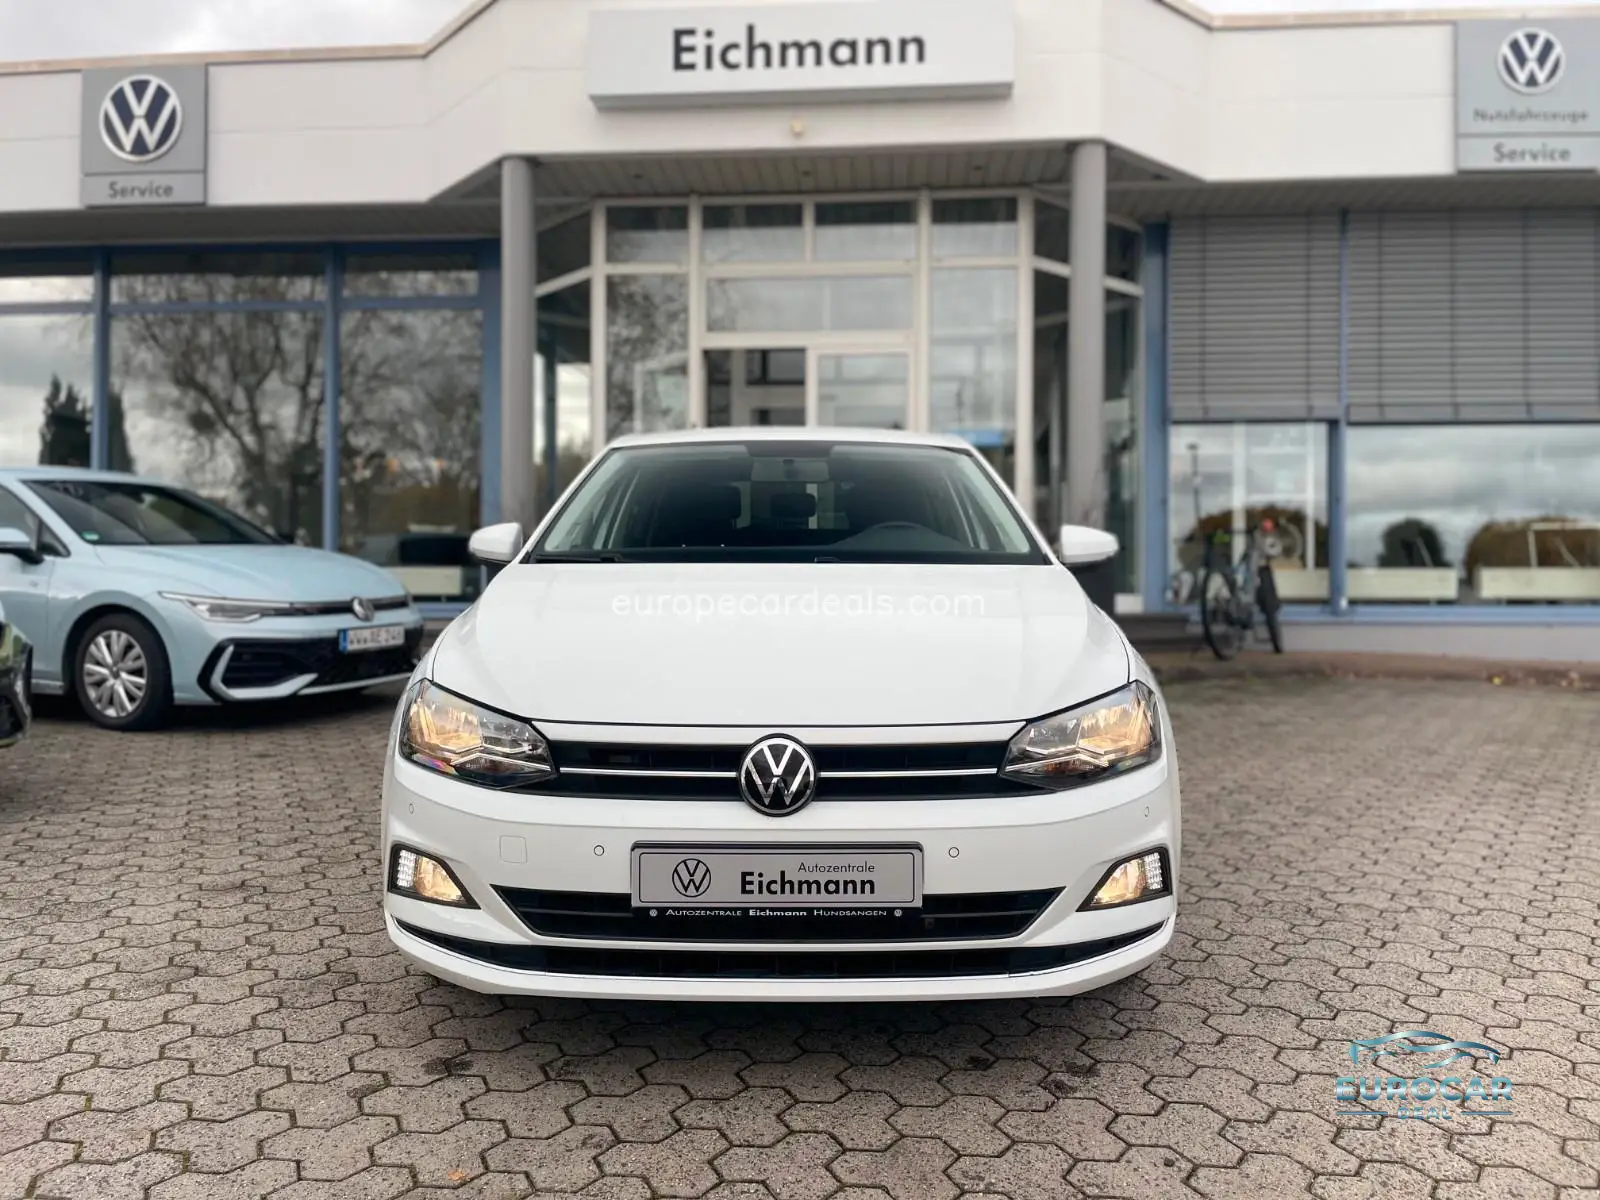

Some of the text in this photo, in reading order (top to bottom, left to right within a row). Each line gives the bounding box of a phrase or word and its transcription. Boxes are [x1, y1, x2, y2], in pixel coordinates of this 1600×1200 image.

[672, 24, 926, 71] Eichmann
[1492, 141, 1571, 163] Service
[108, 180, 174, 199] Service
[797, 862, 876, 873] Autozentrale
[740, 870, 876, 896] Eichmann
[749, 908, 807, 917] Eichmann
